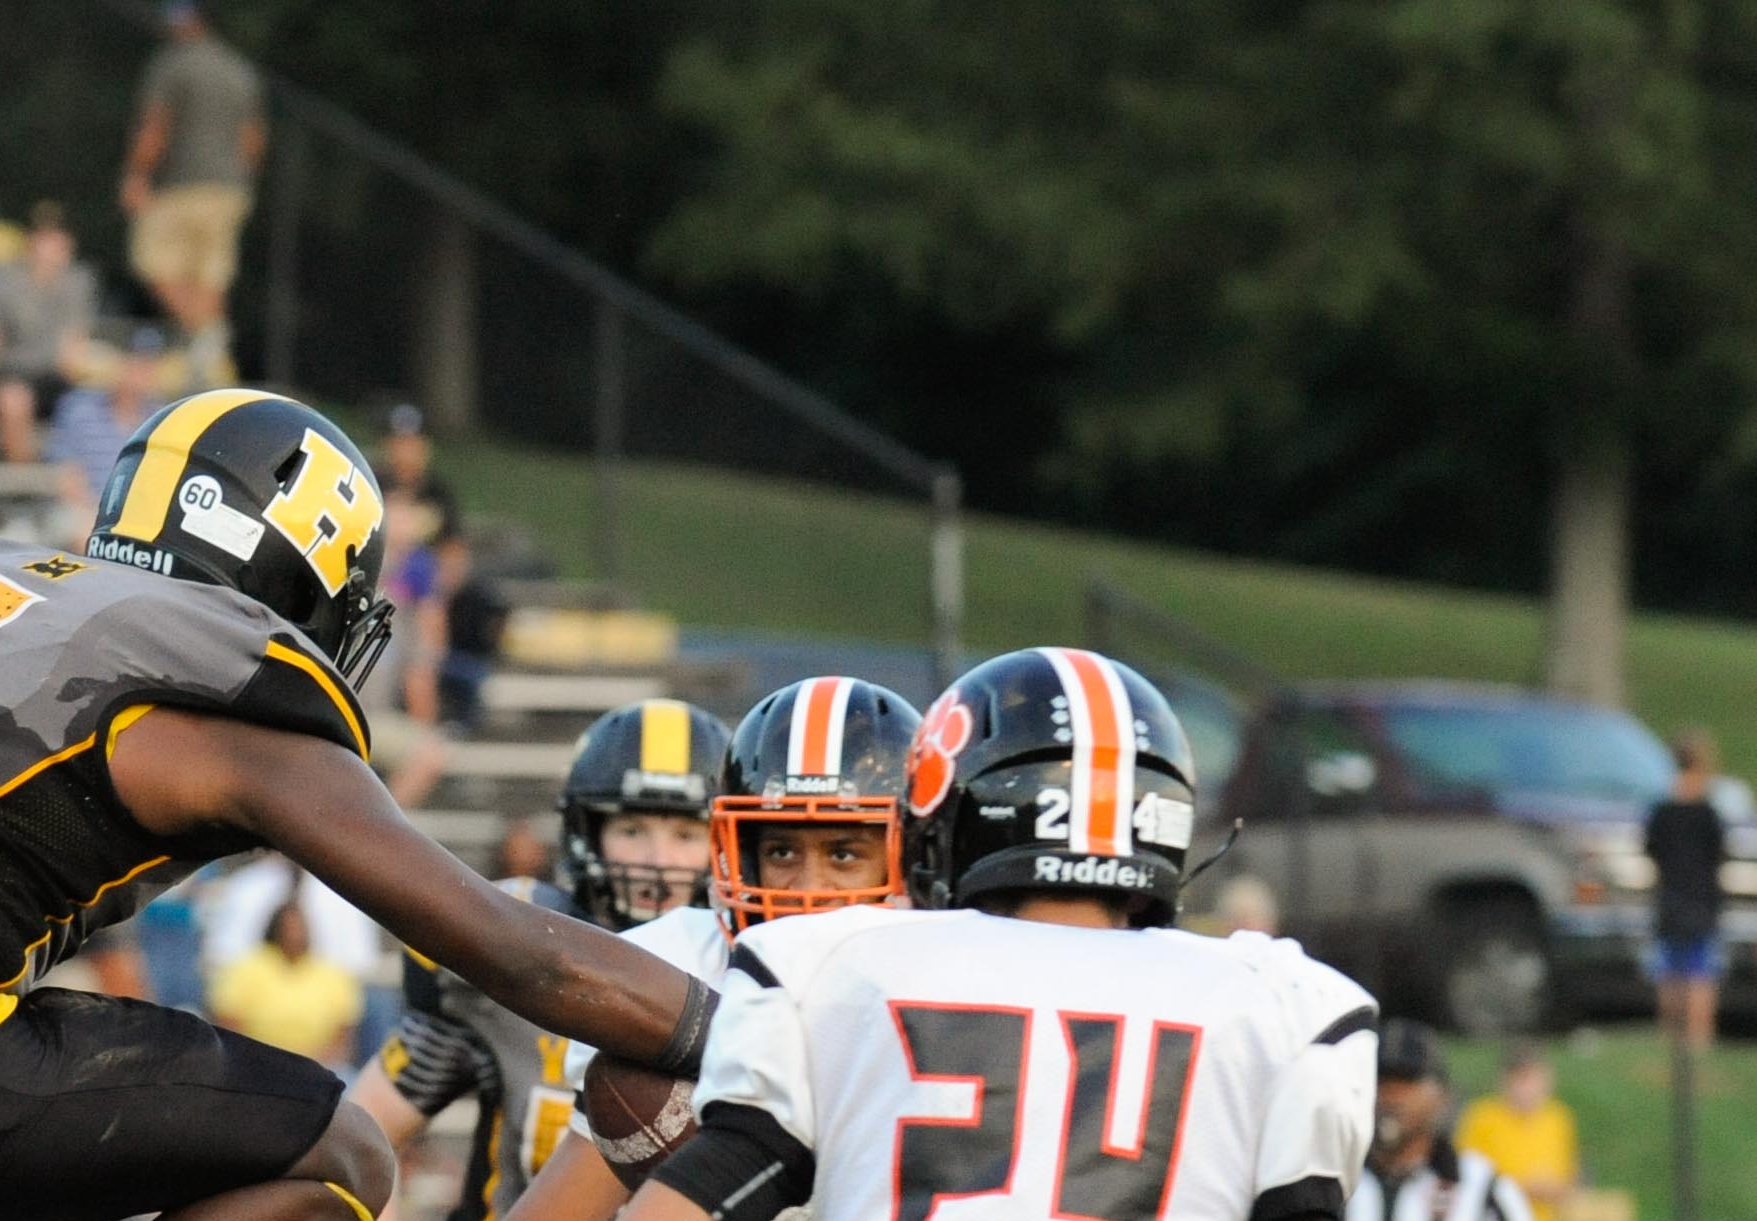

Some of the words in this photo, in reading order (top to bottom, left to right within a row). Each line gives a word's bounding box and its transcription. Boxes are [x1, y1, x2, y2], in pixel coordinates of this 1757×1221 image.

[183, 482, 216, 510] 60
[261, 427, 385, 599] H
[87, 535, 174, 576] Riddell
